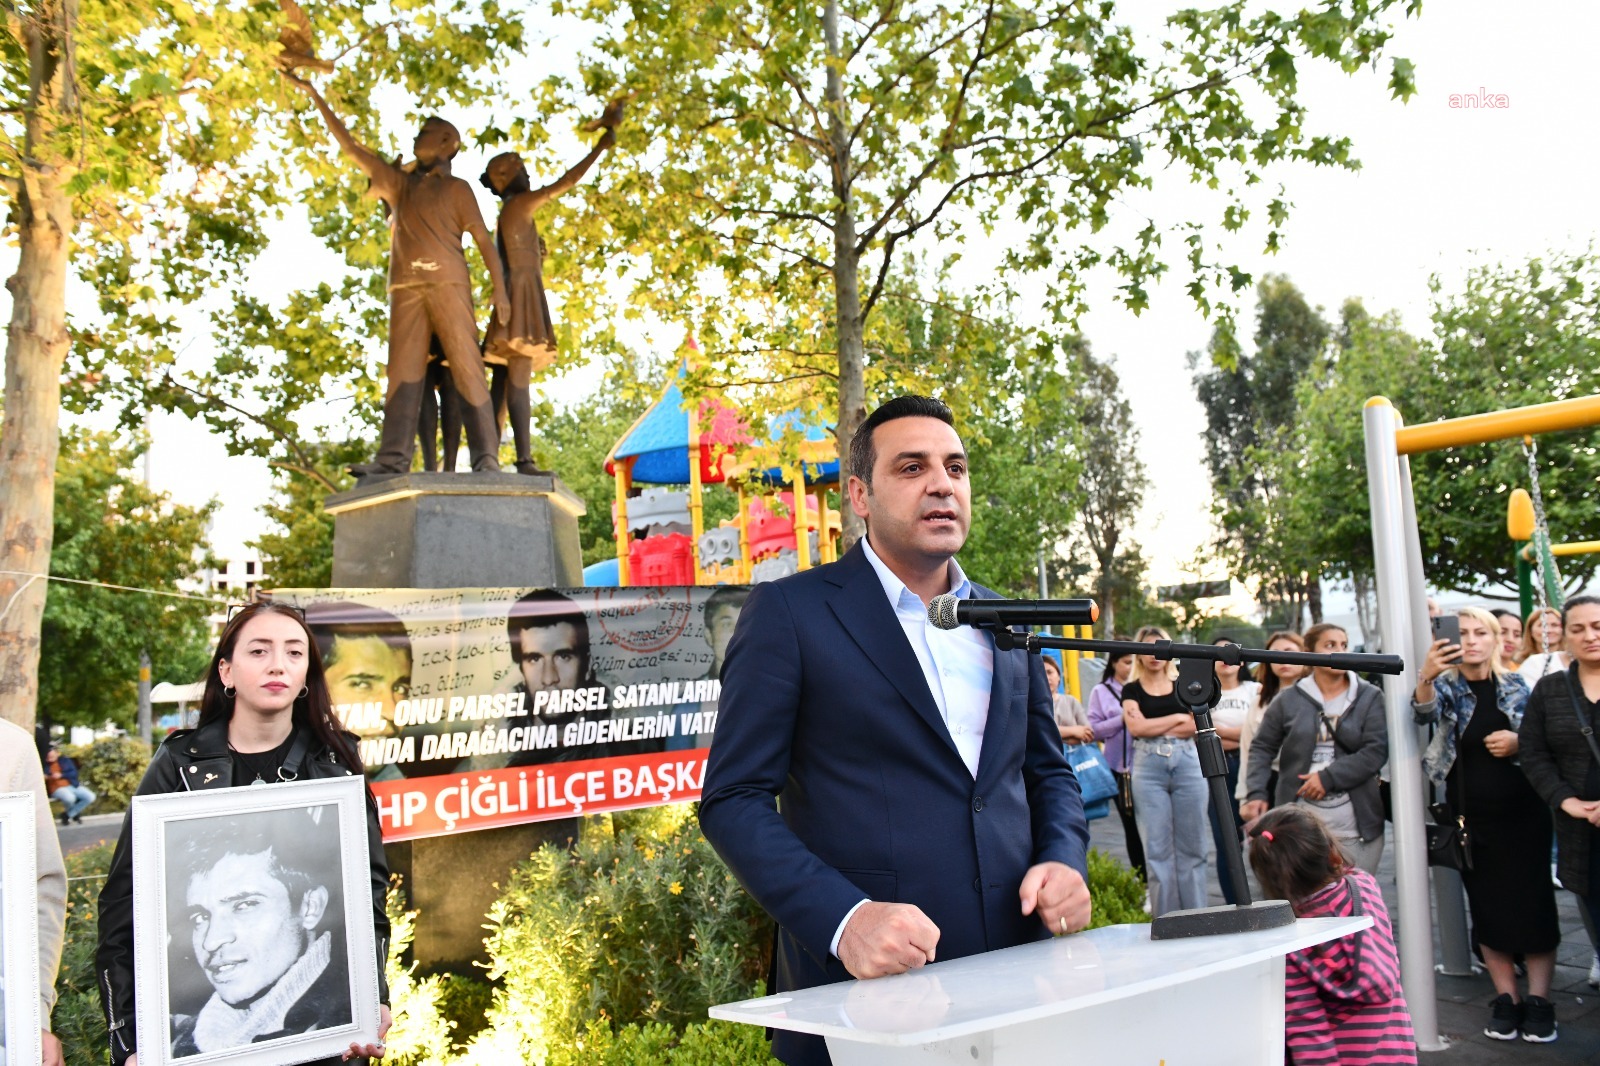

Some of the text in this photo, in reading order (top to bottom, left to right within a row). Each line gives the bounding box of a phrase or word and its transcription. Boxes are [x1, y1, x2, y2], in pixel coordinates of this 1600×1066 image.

[330, 701, 388, 731] TAN,
[393, 697, 443, 727] ONU
[448, 692, 528, 722] PARSEL
[533, 687, 608, 715] PARSEL
[420, 723, 558, 761] DARAĞACINA
[563, 710, 677, 747] GİDENLERİN
[376, 791, 428, 828] HP
[434, 771, 529, 831] ÇİĞLİ
[536, 769, 607, 814] İLÇE
